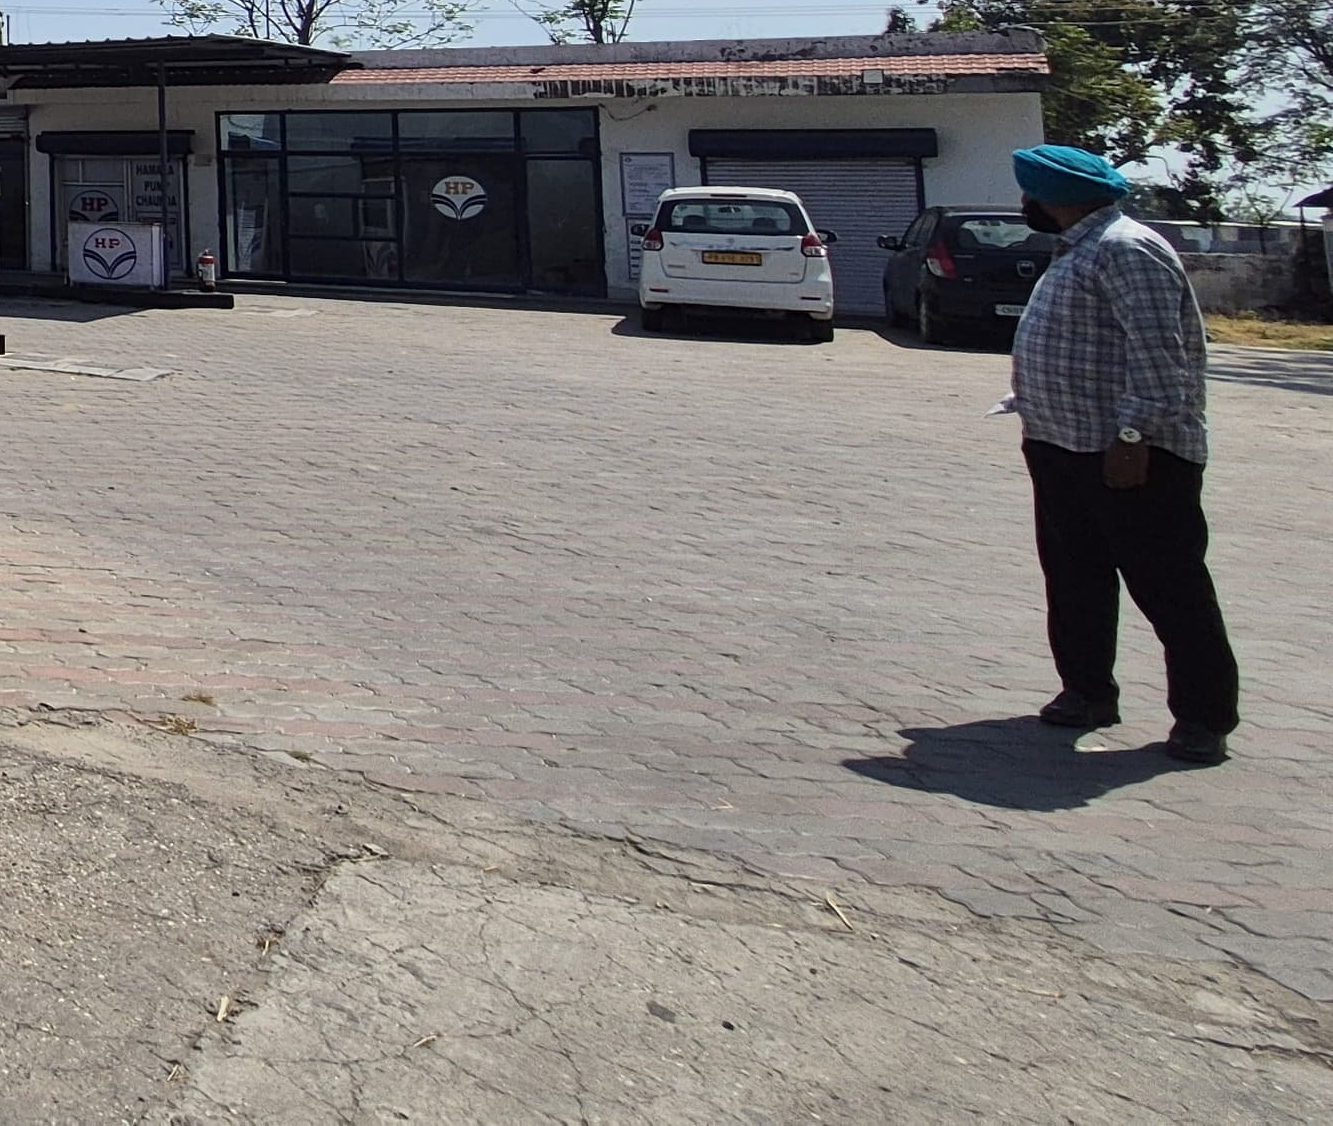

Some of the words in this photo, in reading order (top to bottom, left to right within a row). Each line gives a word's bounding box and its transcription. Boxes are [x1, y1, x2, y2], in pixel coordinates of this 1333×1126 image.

[444, 181, 476, 195] HP
[80, 197, 109, 212] HP
[94, 237, 121, 249] HP
